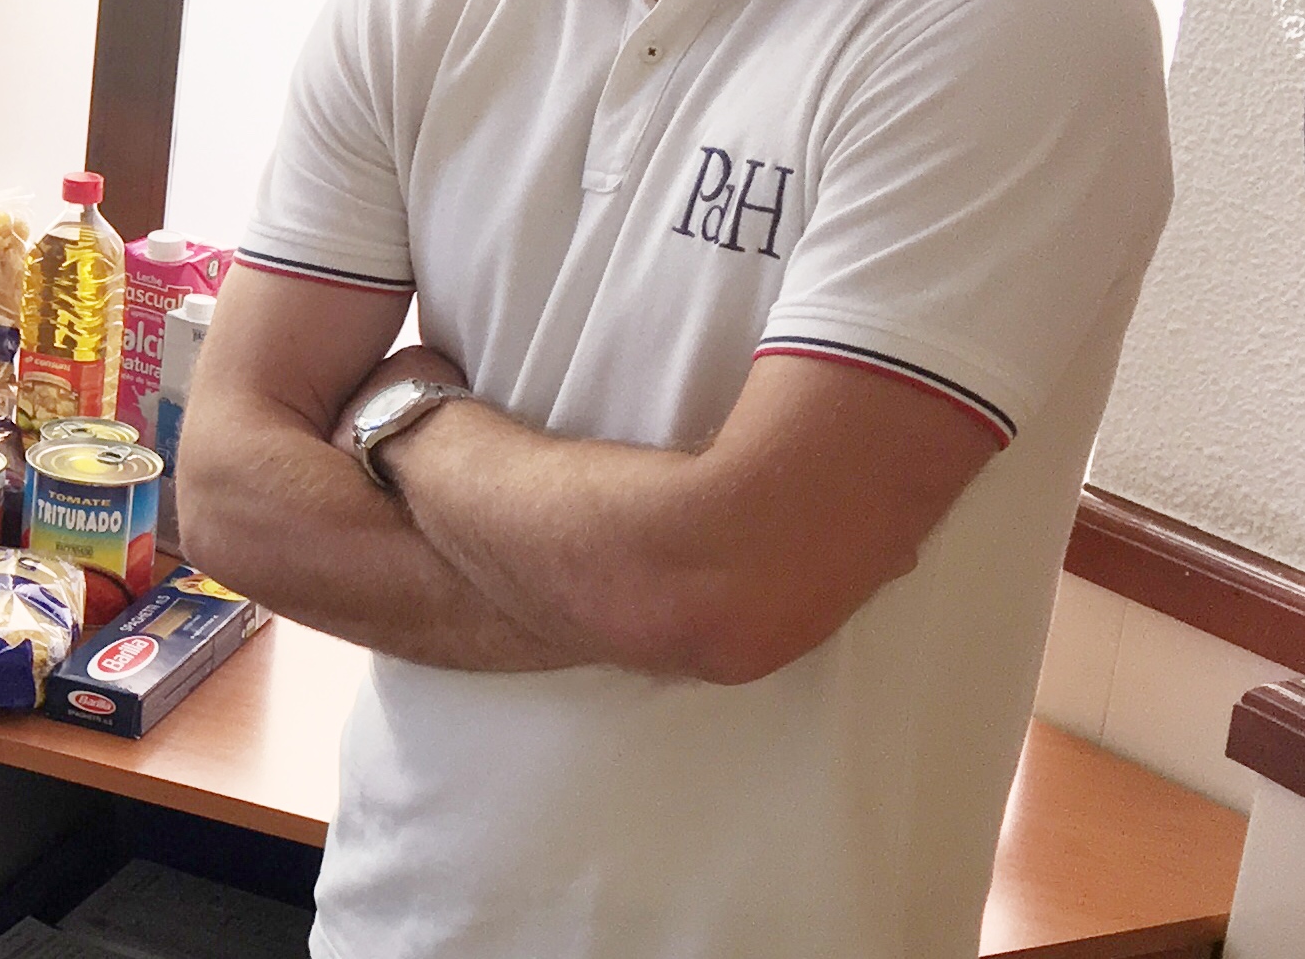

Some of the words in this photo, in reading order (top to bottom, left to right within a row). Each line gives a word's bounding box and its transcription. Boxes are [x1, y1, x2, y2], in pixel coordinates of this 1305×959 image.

[671, 146, 794, 260] PdH
[34, 358, 71, 371] consum
[48, 489, 111, 507] TOMATE
[37, 498, 123, 533] TRITURADO
[101, 638, 151, 672] Barilla
[78, 695, 113, 711] Barilla
